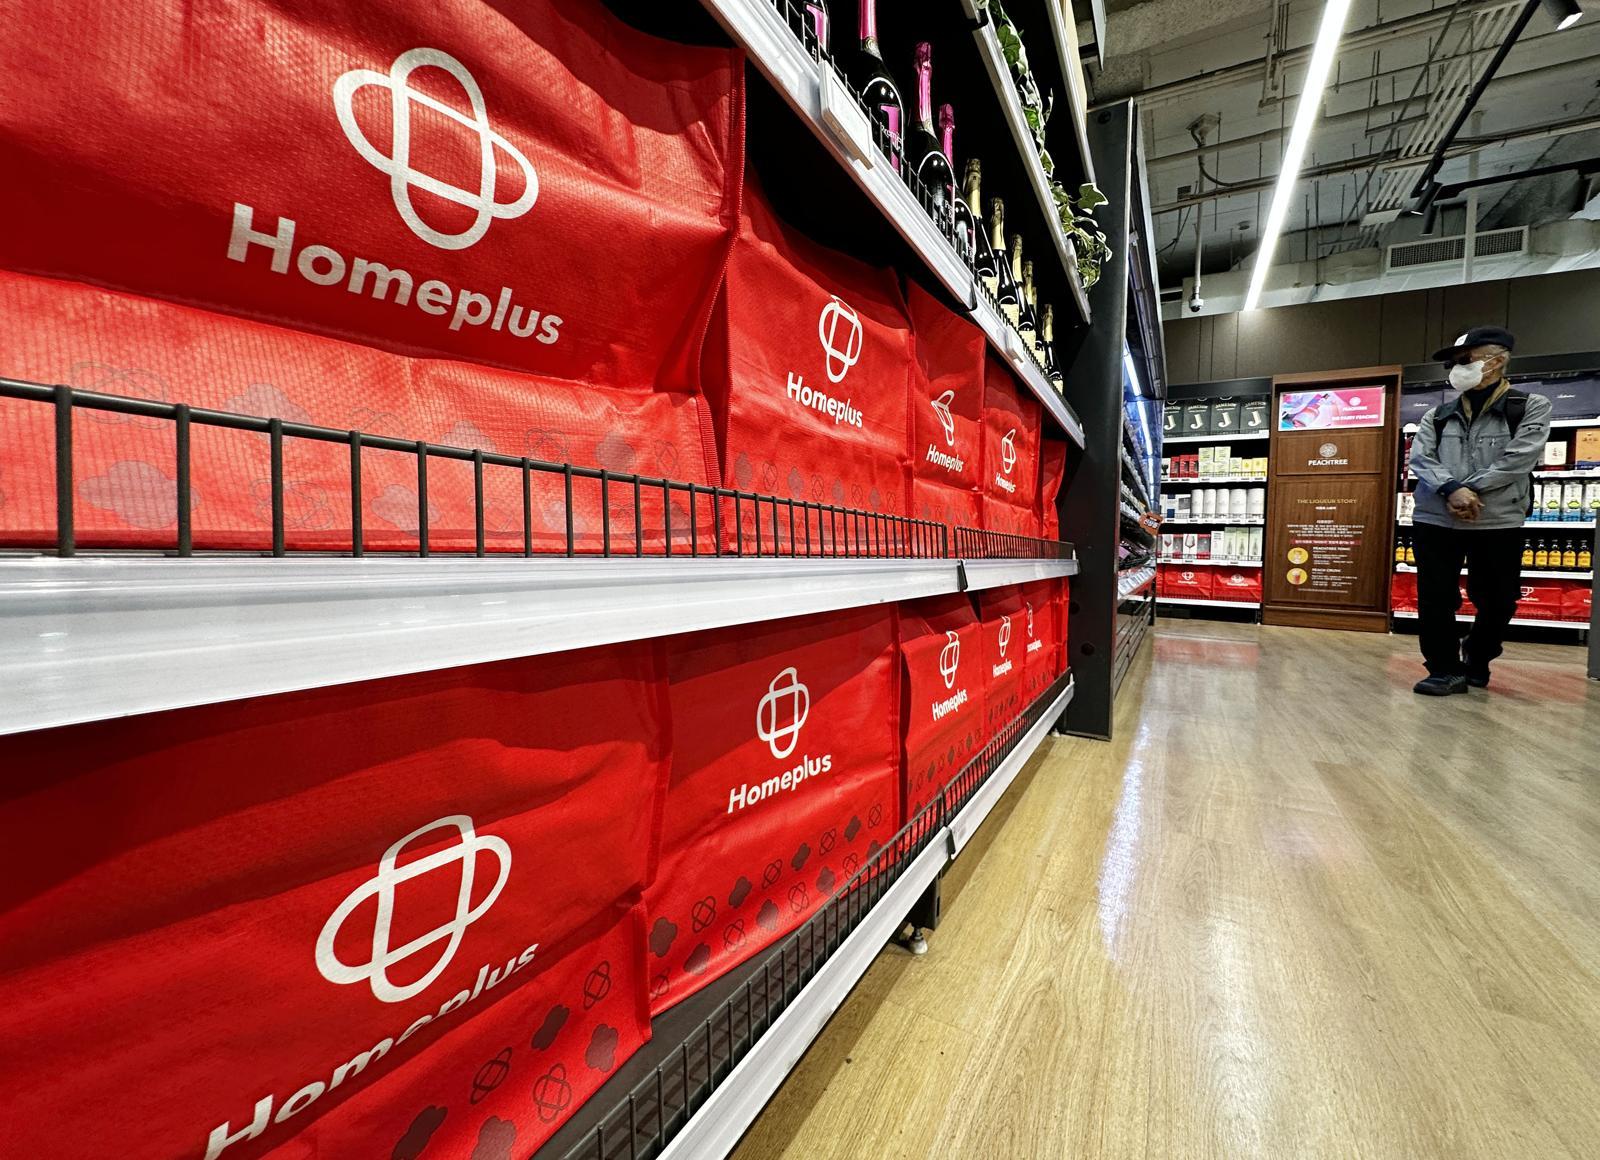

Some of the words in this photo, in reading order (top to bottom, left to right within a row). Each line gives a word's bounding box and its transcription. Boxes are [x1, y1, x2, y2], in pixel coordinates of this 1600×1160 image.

[227, 202, 564, 345] Homeplus
[787, 371, 863, 428] Homeplus
[1190, 414, 1203, 429] J
[1218, 412, 1232, 427] J
[1248, 411, 1261, 426] J
[926, 444, 964, 473] Homeplus
[932, 689, 968, 721] Homeplus
[727, 754, 832, 814] Homeplus
[204, 943, 539, 1160] Homeplus
